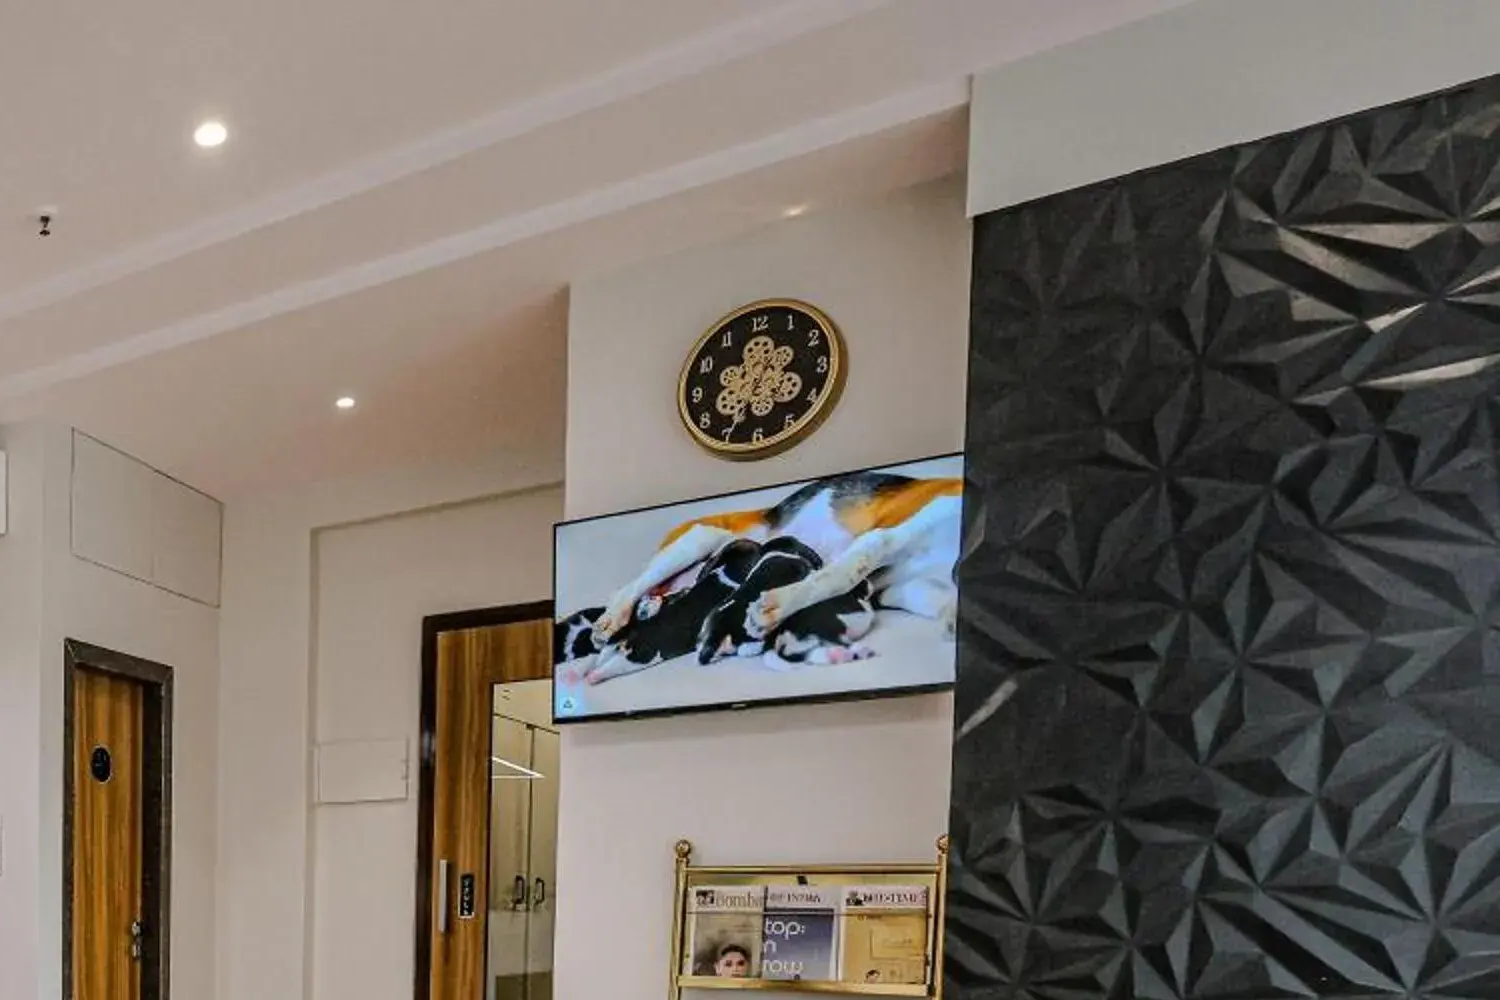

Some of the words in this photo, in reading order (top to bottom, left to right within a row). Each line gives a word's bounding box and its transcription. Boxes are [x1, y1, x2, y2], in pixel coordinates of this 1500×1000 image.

[751, 315, 769, 332] 12
[787, 314, 795, 330] 1
[721, 331, 732, 348] 11
[807, 329, 820, 347] 2
[699, 356, 713, 373] 10
[816, 356, 828, 373] 3
[691, 387, 703, 402] 9
[806, 388, 818, 404] 4
[699, 412, 711, 429] 8
[784, 414, 795, 429] 5
[721, 427, 733, 443] 7
[752, 427, 764, 443] 6
